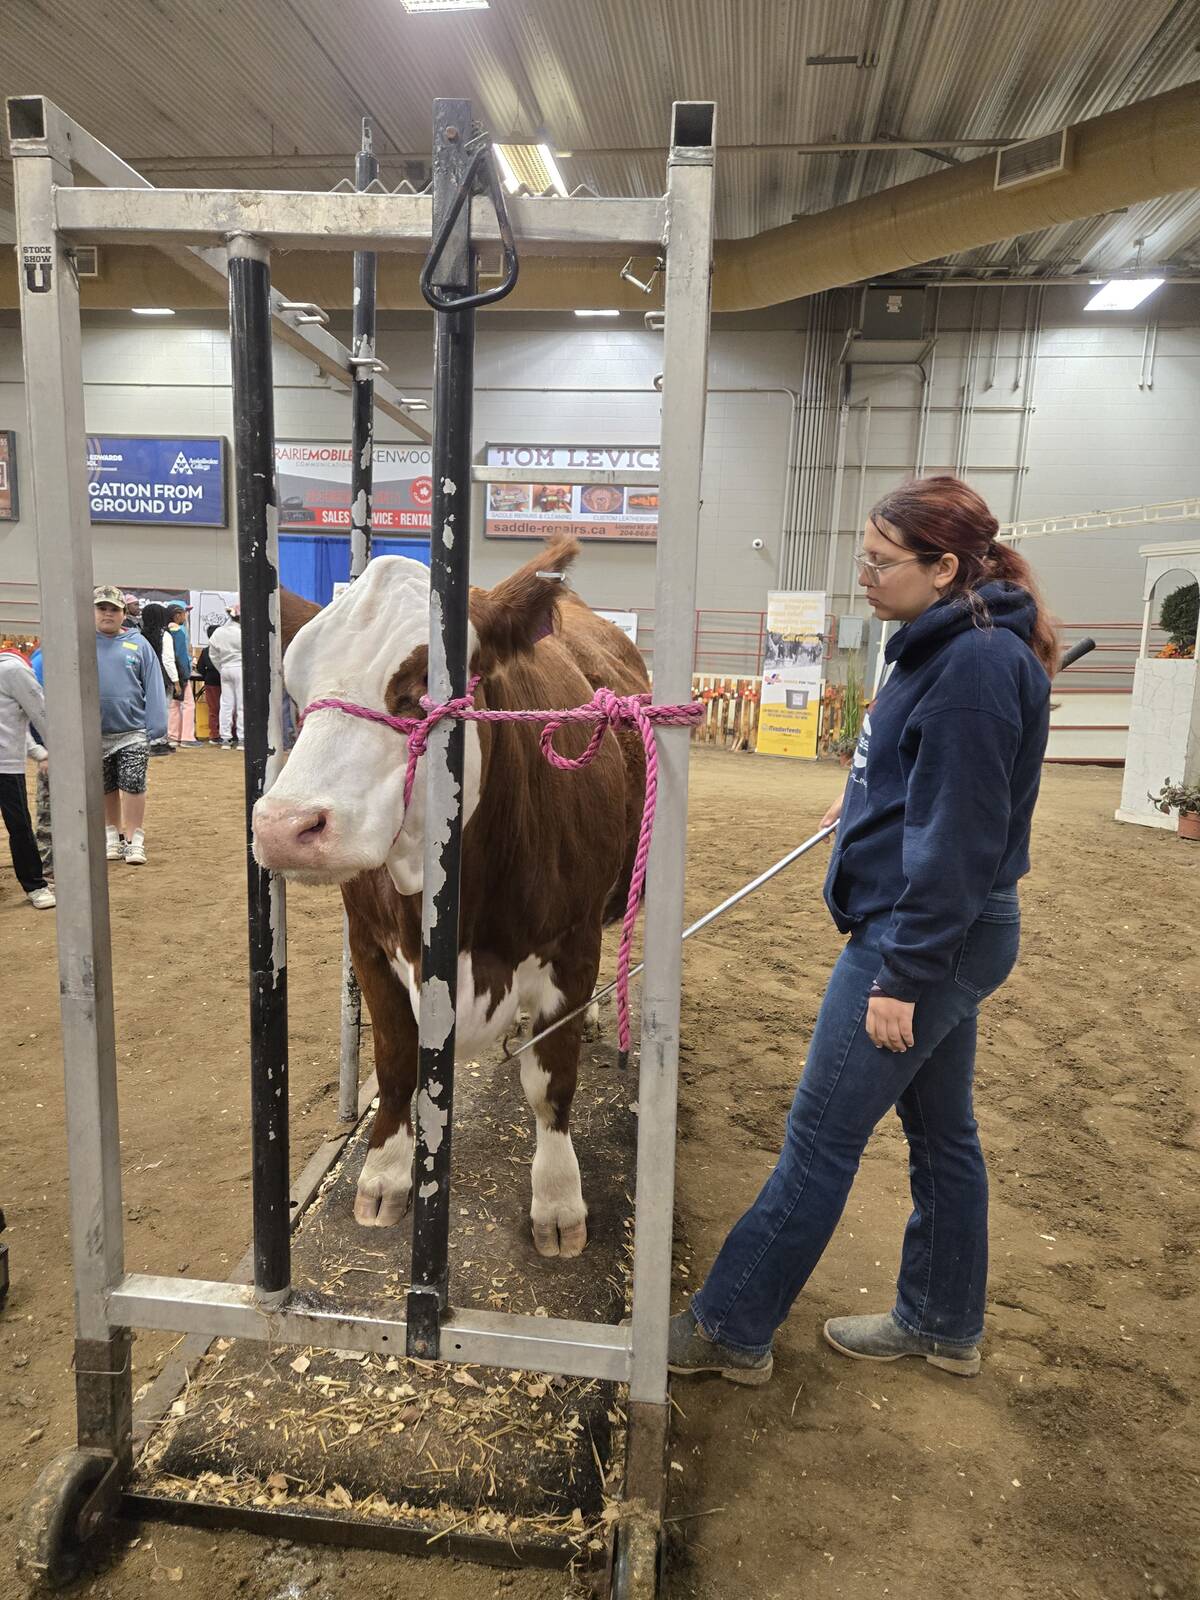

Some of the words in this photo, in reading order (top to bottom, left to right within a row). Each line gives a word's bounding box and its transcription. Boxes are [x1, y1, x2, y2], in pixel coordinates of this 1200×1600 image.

[24, 255, 52, 263] SHOW
[24, 263, 53, 293] U
[497, 447, 555, 466] TOM
[88, 482, 151, 497] CATION
[154, 484, 203, 499] FROM
[91, 498, 165, 514] GROUND
[168, 500, 193, 514] UP
[322, 510, 350, 524] SALES
[371, 511, 394, 525] VICE
[494, 522, 606, 535] saddle-repairs.ca
